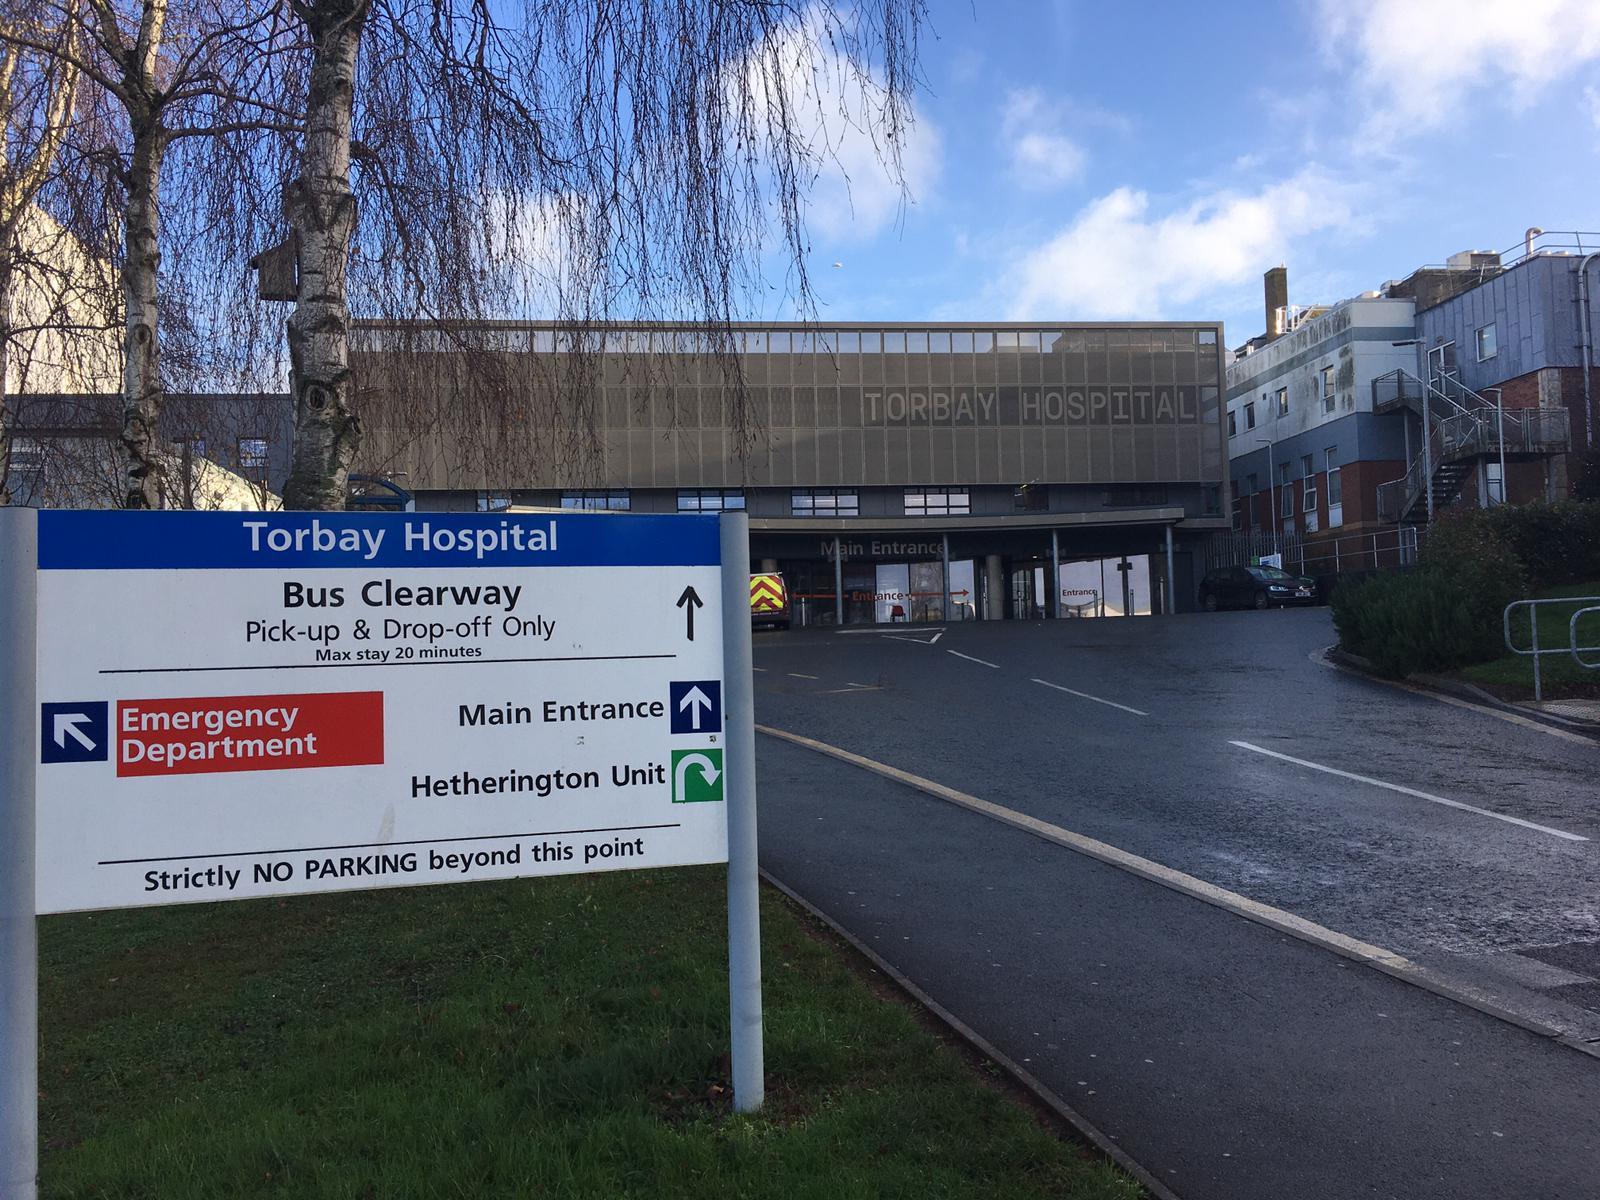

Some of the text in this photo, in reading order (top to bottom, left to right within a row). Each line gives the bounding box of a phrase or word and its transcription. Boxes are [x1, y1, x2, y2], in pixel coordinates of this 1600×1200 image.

[864, 391, 1195, 421] TORBAY HOSPITAL
[243, 519, 558, 560] Torbay Hospital
[871, 541, 945, 555] Entrance
[283, 579, 522, 611] Bus Clearway
[852, 591, 904, 601] Entrance
[1062, 588, 1098, 597] Entrance
[246, 615, 556, 646] Pick-up & Drop-off Only
[315, 645, 482, 662] Max stay 20 minutes
[122, 706, 299, 735] Emergency
[459, 700, 665, 726] Main Entrance
[122, 732, 317, 767] Department
[411, 762, 666, 798] Hetherington Unit
[144, 837, 644, 891] Strictly NO PARKING beyond this point
